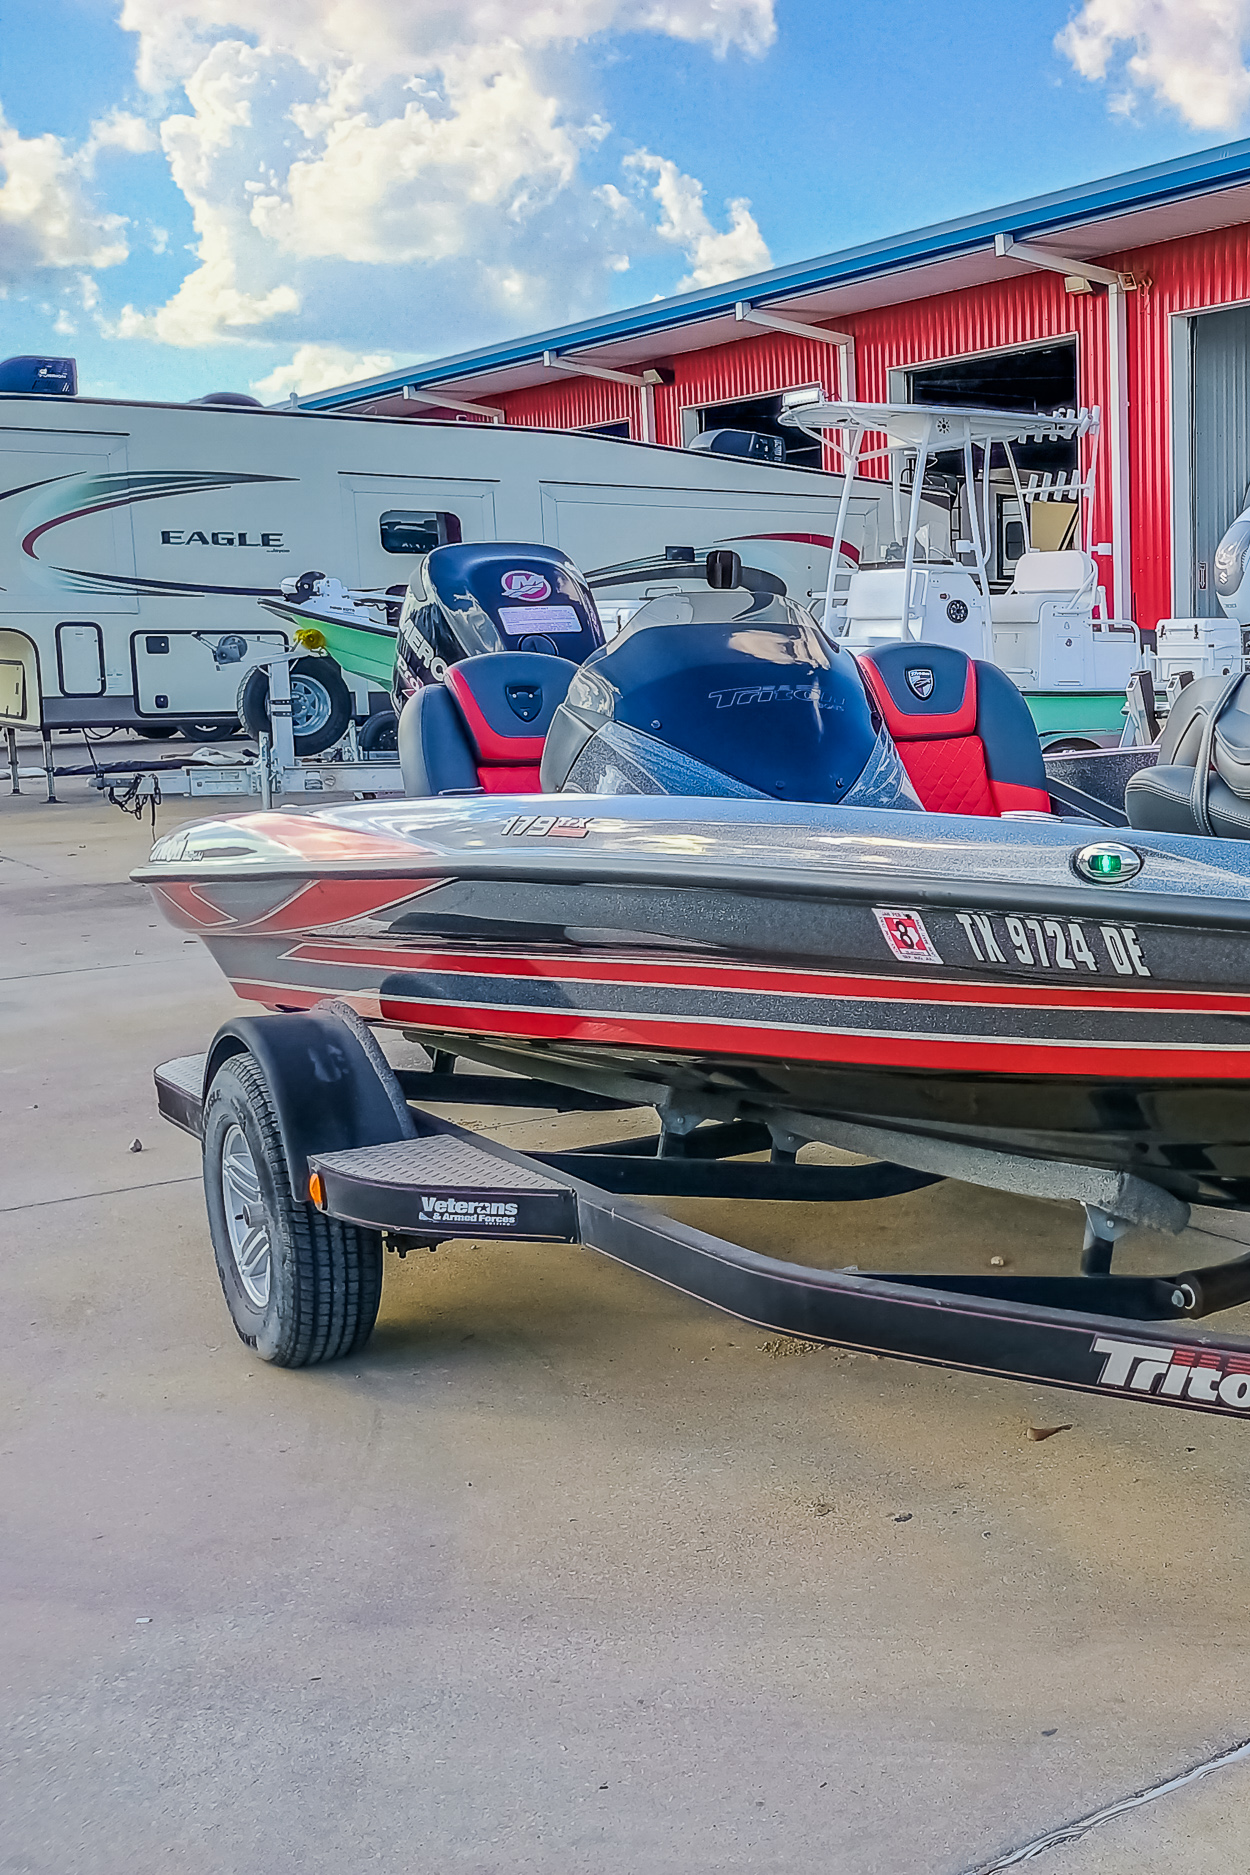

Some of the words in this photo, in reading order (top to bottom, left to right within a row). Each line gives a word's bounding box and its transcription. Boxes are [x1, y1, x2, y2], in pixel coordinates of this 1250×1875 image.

[161, 530, 284, 547] EAGLE
[500, 815, 559, 836] 179
[955, 913, 1007, 963] TX
[1004, 916, 1098, 972] 9724
[1099, 926, 1152, 977] DE
[421, 1196, 518, 1215] Veterans
[432, 1212, 441, 1221] &
[442, 1212, 478, 1223] Armed
[478, 1214, 516, 1224] Forces
